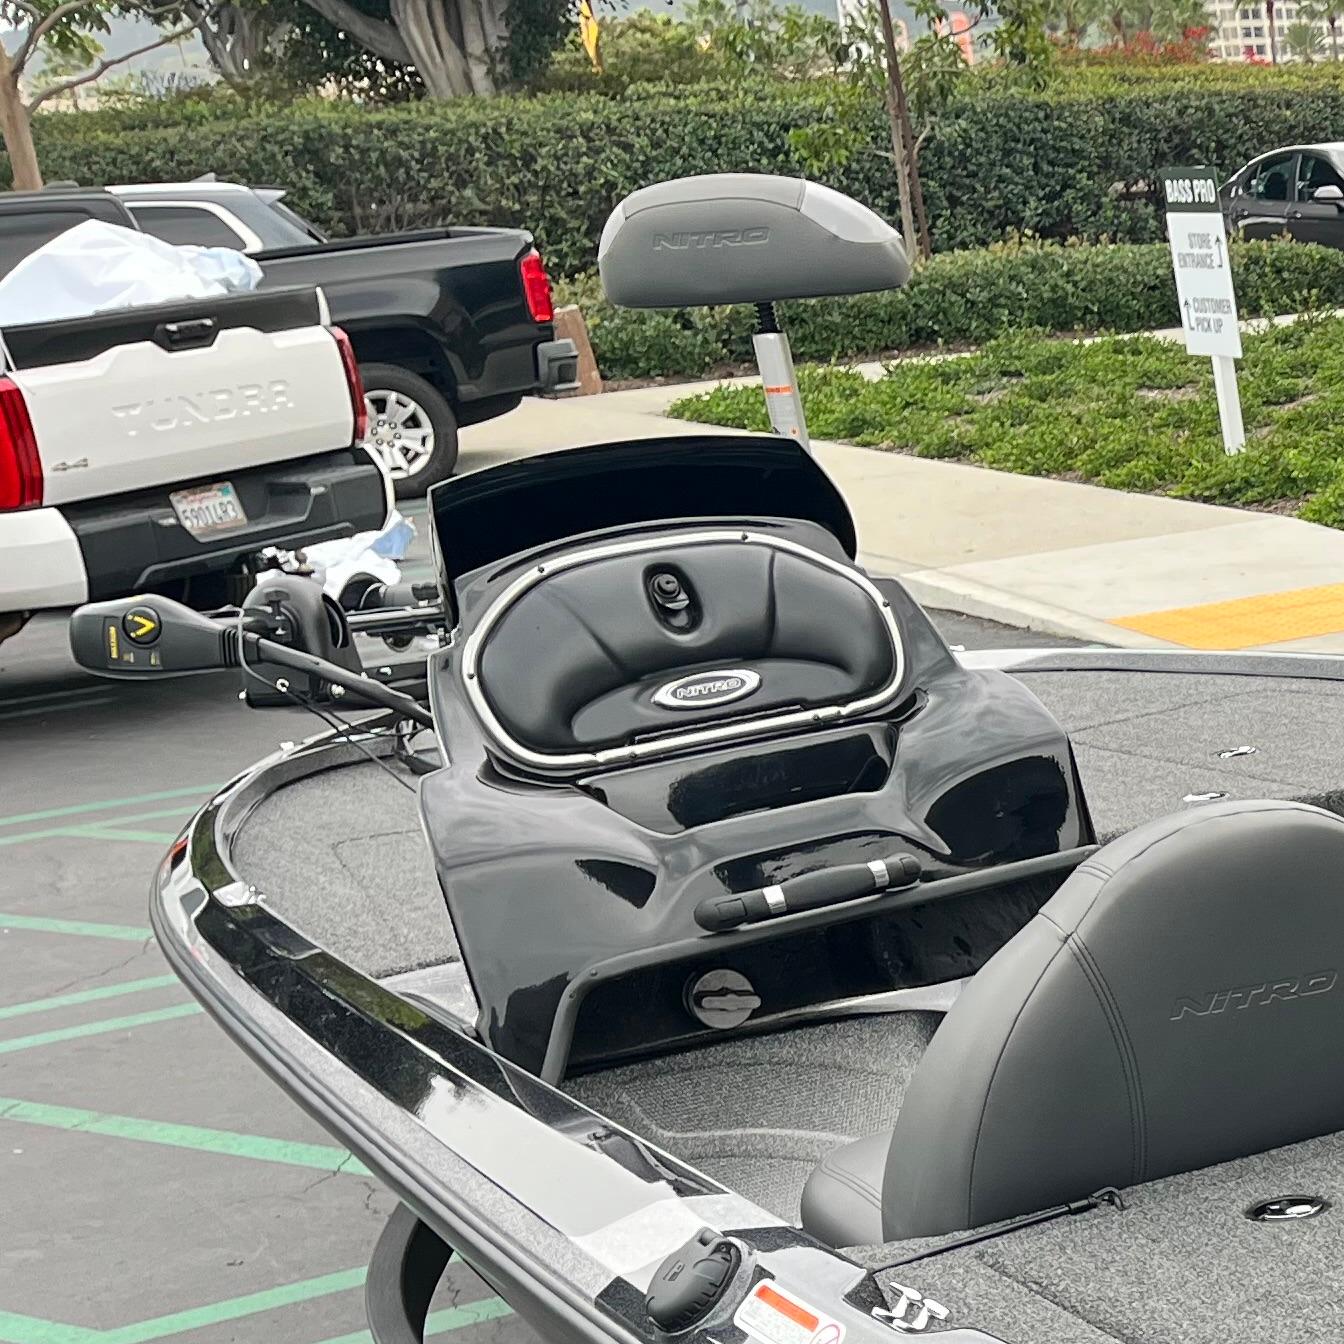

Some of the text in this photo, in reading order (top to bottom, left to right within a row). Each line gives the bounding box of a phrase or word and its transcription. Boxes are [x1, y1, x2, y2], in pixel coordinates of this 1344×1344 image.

[1165, 178, 1216, 203] BASS PRO
[653, 226, 771, 251] NITRO
[1188, 233, 1212, 250] STORE
[1178, 252, 1215, 270] ENTRANCE
[1193, 297, 1232, 316] CUSTOMER
[1195, 317, 1223, 333] PICK UP
[111, 378, 294, 437] TUNDRA
[677, 678, 742, 699] NITRO
[1169, 968, 1338, 1021] NITRO
